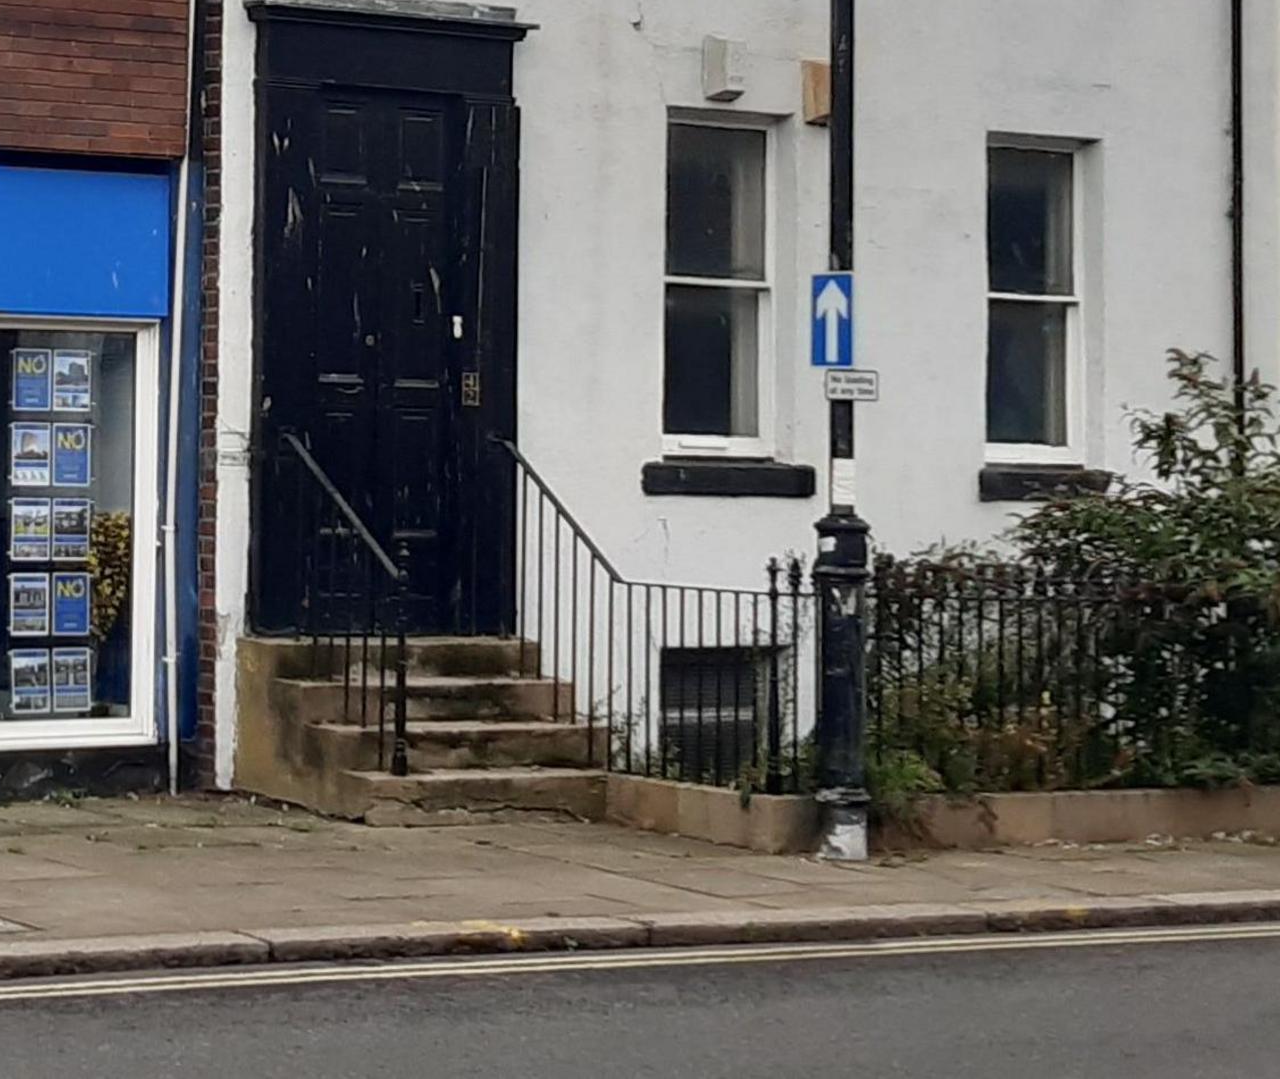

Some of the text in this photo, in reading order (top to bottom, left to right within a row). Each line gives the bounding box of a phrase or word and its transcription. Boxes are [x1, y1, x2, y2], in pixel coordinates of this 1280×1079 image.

[17, 355, 47, 374] NO
[57, 429, 85, 450] NO
[57, 578, 85, 598] NO
